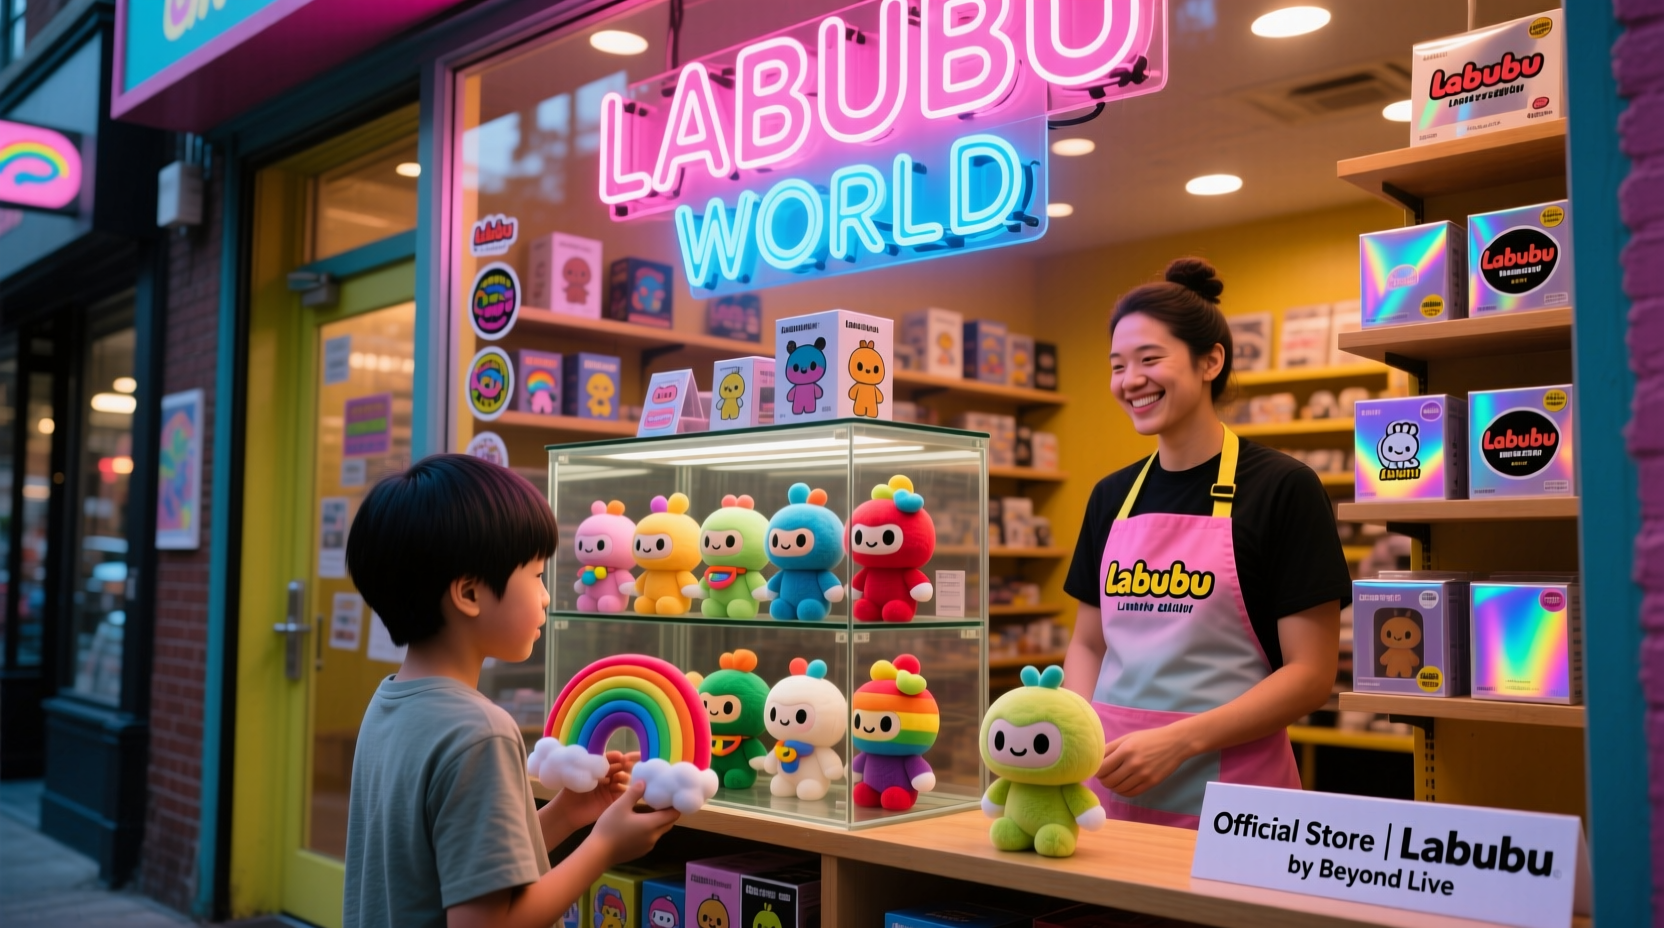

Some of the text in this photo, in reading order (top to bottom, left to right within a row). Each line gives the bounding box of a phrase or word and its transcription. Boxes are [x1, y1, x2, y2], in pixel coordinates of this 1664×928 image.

[1429, 52, 1545, 100] Labubu
[599, 0, 1140, 204] LABUBU
[675, 133, 1024, 287] WORLD
[1481, 243, 1556, 270] Labubu
[1483, 427, 1556, 450] Labubu
[1105, 559, 1215, 600] Labubu
[1213, 811, 1554, 877] Official Store Labubu
[1287, 854, 1455, 896] by Beyond Live
